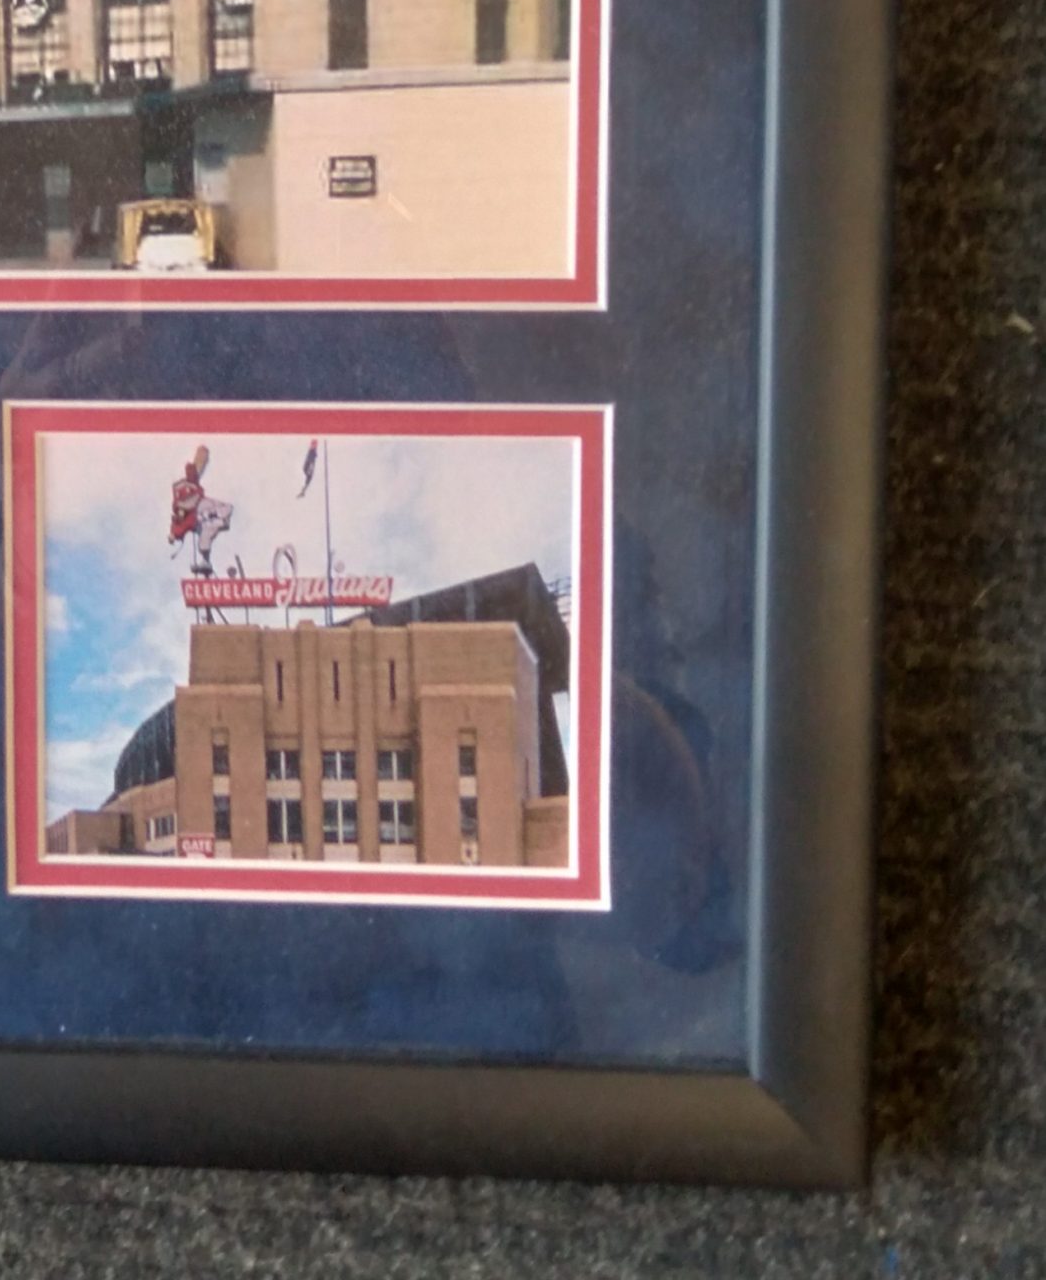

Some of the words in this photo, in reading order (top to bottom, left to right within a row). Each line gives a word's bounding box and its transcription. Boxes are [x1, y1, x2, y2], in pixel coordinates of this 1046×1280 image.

[184, 581, 274, 601] CLEVELAND
[272, 543, 389, 609] Indians
[182, 839, 211, 853] GATE
